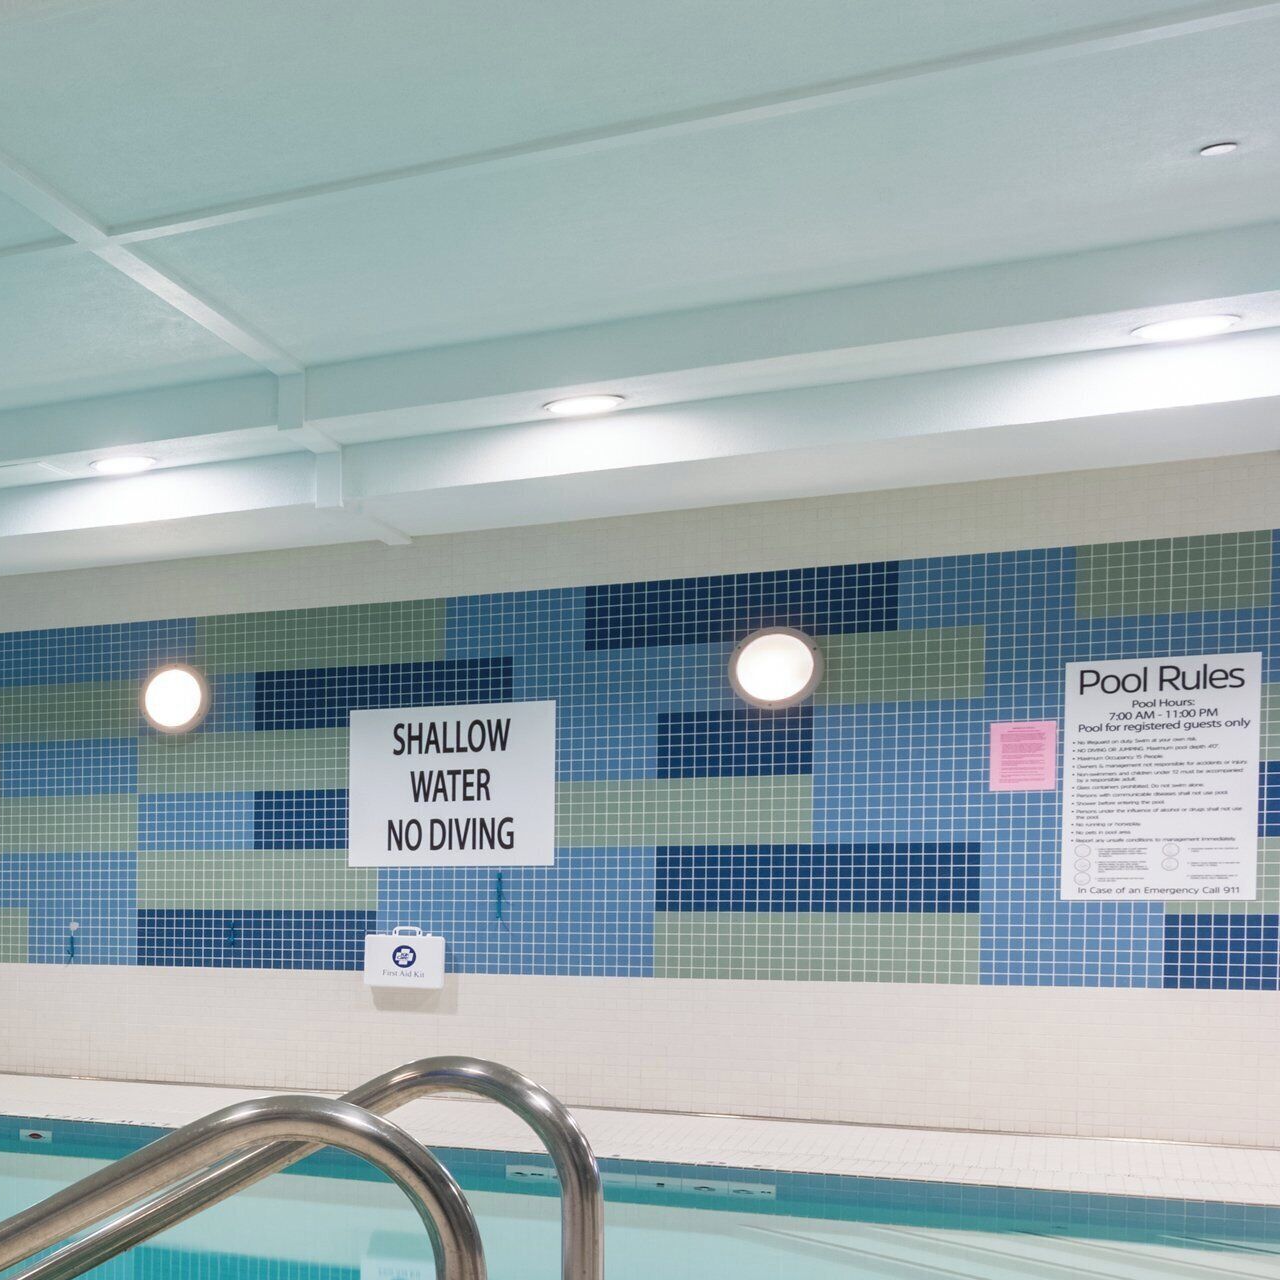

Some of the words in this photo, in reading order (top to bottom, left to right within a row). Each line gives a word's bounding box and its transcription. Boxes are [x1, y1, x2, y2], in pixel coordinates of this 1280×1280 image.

[1080, 666, 1148, 695] Pool
[1159, 663, 1245, 692] Rules
[1132, 699, 1156, 708] Pool
[1159, 698, 1195, 707] Hours:
[1109, 711, 1132, 721] 7:00
[1135, 711, 1155, 719] AM
[1166, 709, 1196, 719] 11:00
[1199, 708, 1218, 717] PM
[1078, 723, 1103, 733] Pool
[1105, 722, 1121, 731] for
[1123, 721, 1181, 733] registered
[1183, 720, 1222, 731] guests
[1224, 718, 1251, 729] only
[393, 718, 511, 755] SHALLOW
[410, 768, 491, 802] WATER
[387, 818, 422, 851] NO
[430, 817, 514, 850] DIVING
[1115, 886, 1125, 894] of
[1144, 886, 1199, 895] Emergency
[1202, 886, 1220, 894] Call
[382, 969, 397, 977] First
[399, 969, 412, 977] Aid
[413, 970, 425, 978] Kit
